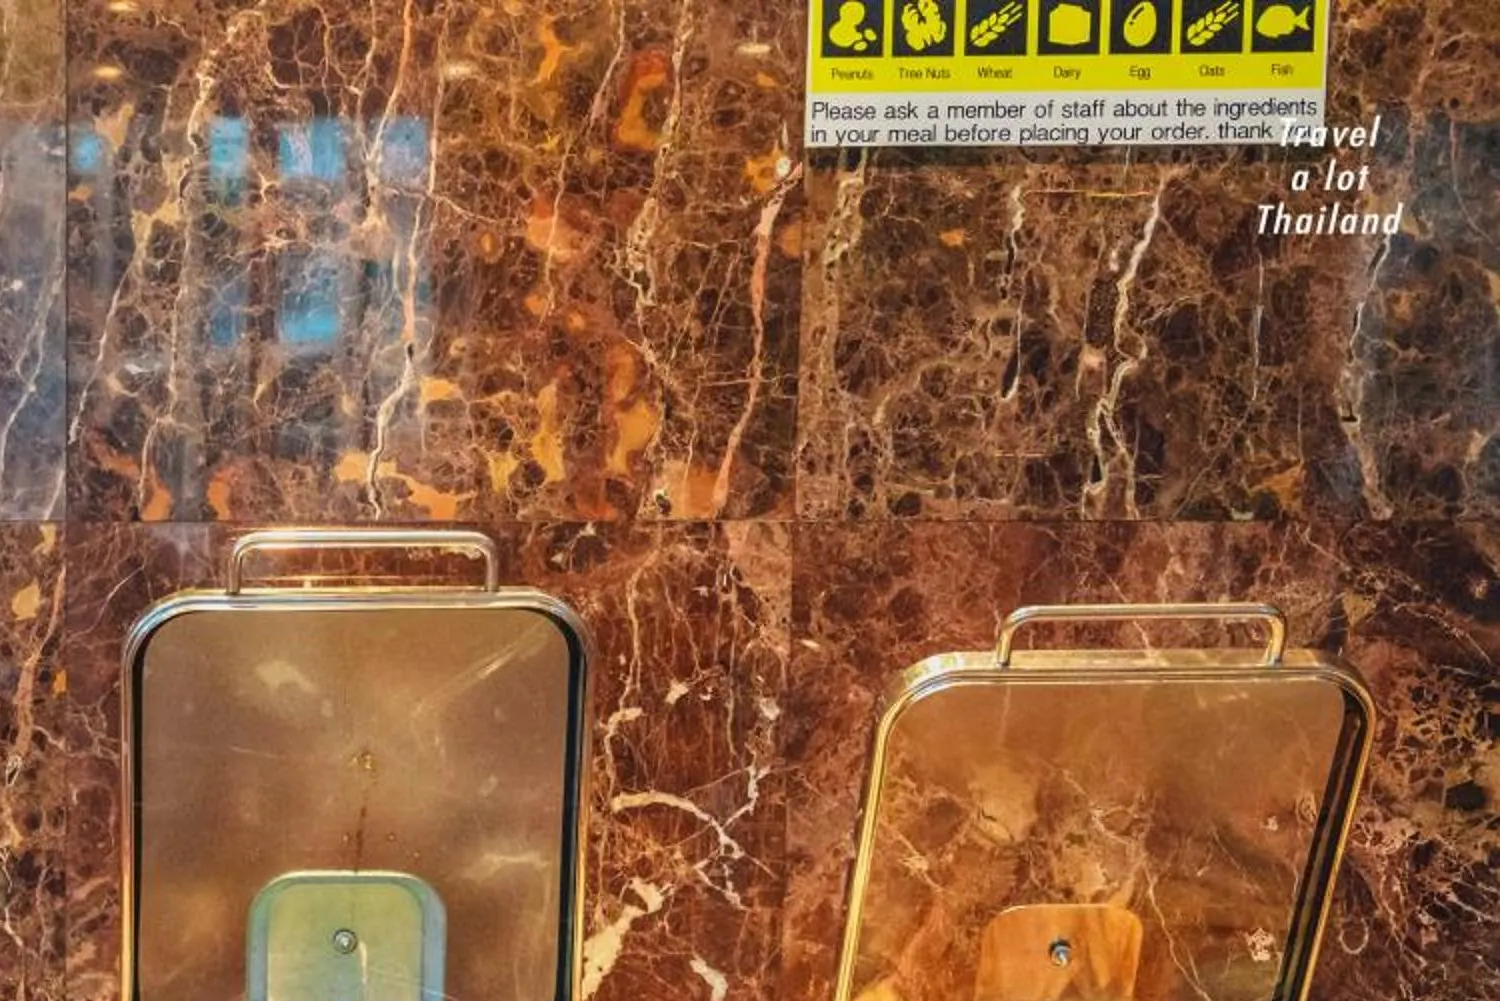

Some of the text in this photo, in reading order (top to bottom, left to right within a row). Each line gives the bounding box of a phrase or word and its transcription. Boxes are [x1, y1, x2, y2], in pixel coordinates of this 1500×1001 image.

[831, 68, 874, 80] Peanuts
[899, 67, 951, 79] Tree Nuts
[977, 66, 1013, 79] Wheat
[1053, 65, 1082, 80] Dairy
[1129, 65, 1151, 80] Egg
[1199, 64, 1225, 77] Oats
[1271, 63, 1293, 75] Fish
[811, 97, 1318, 120] Please ask a member of staff about the ingredients
[811, 125, 827, 143] in
[835, 128, 880, 145] your
[887, 124, 937, 143] meal
[945, 123, 1011, 142] before
[1019, 123, 1089, 144] placing
[1097, 126, 1143, 144] your
[1151, 122, 1210, 141] order.
[1218, 121, 1272, 140] thank
